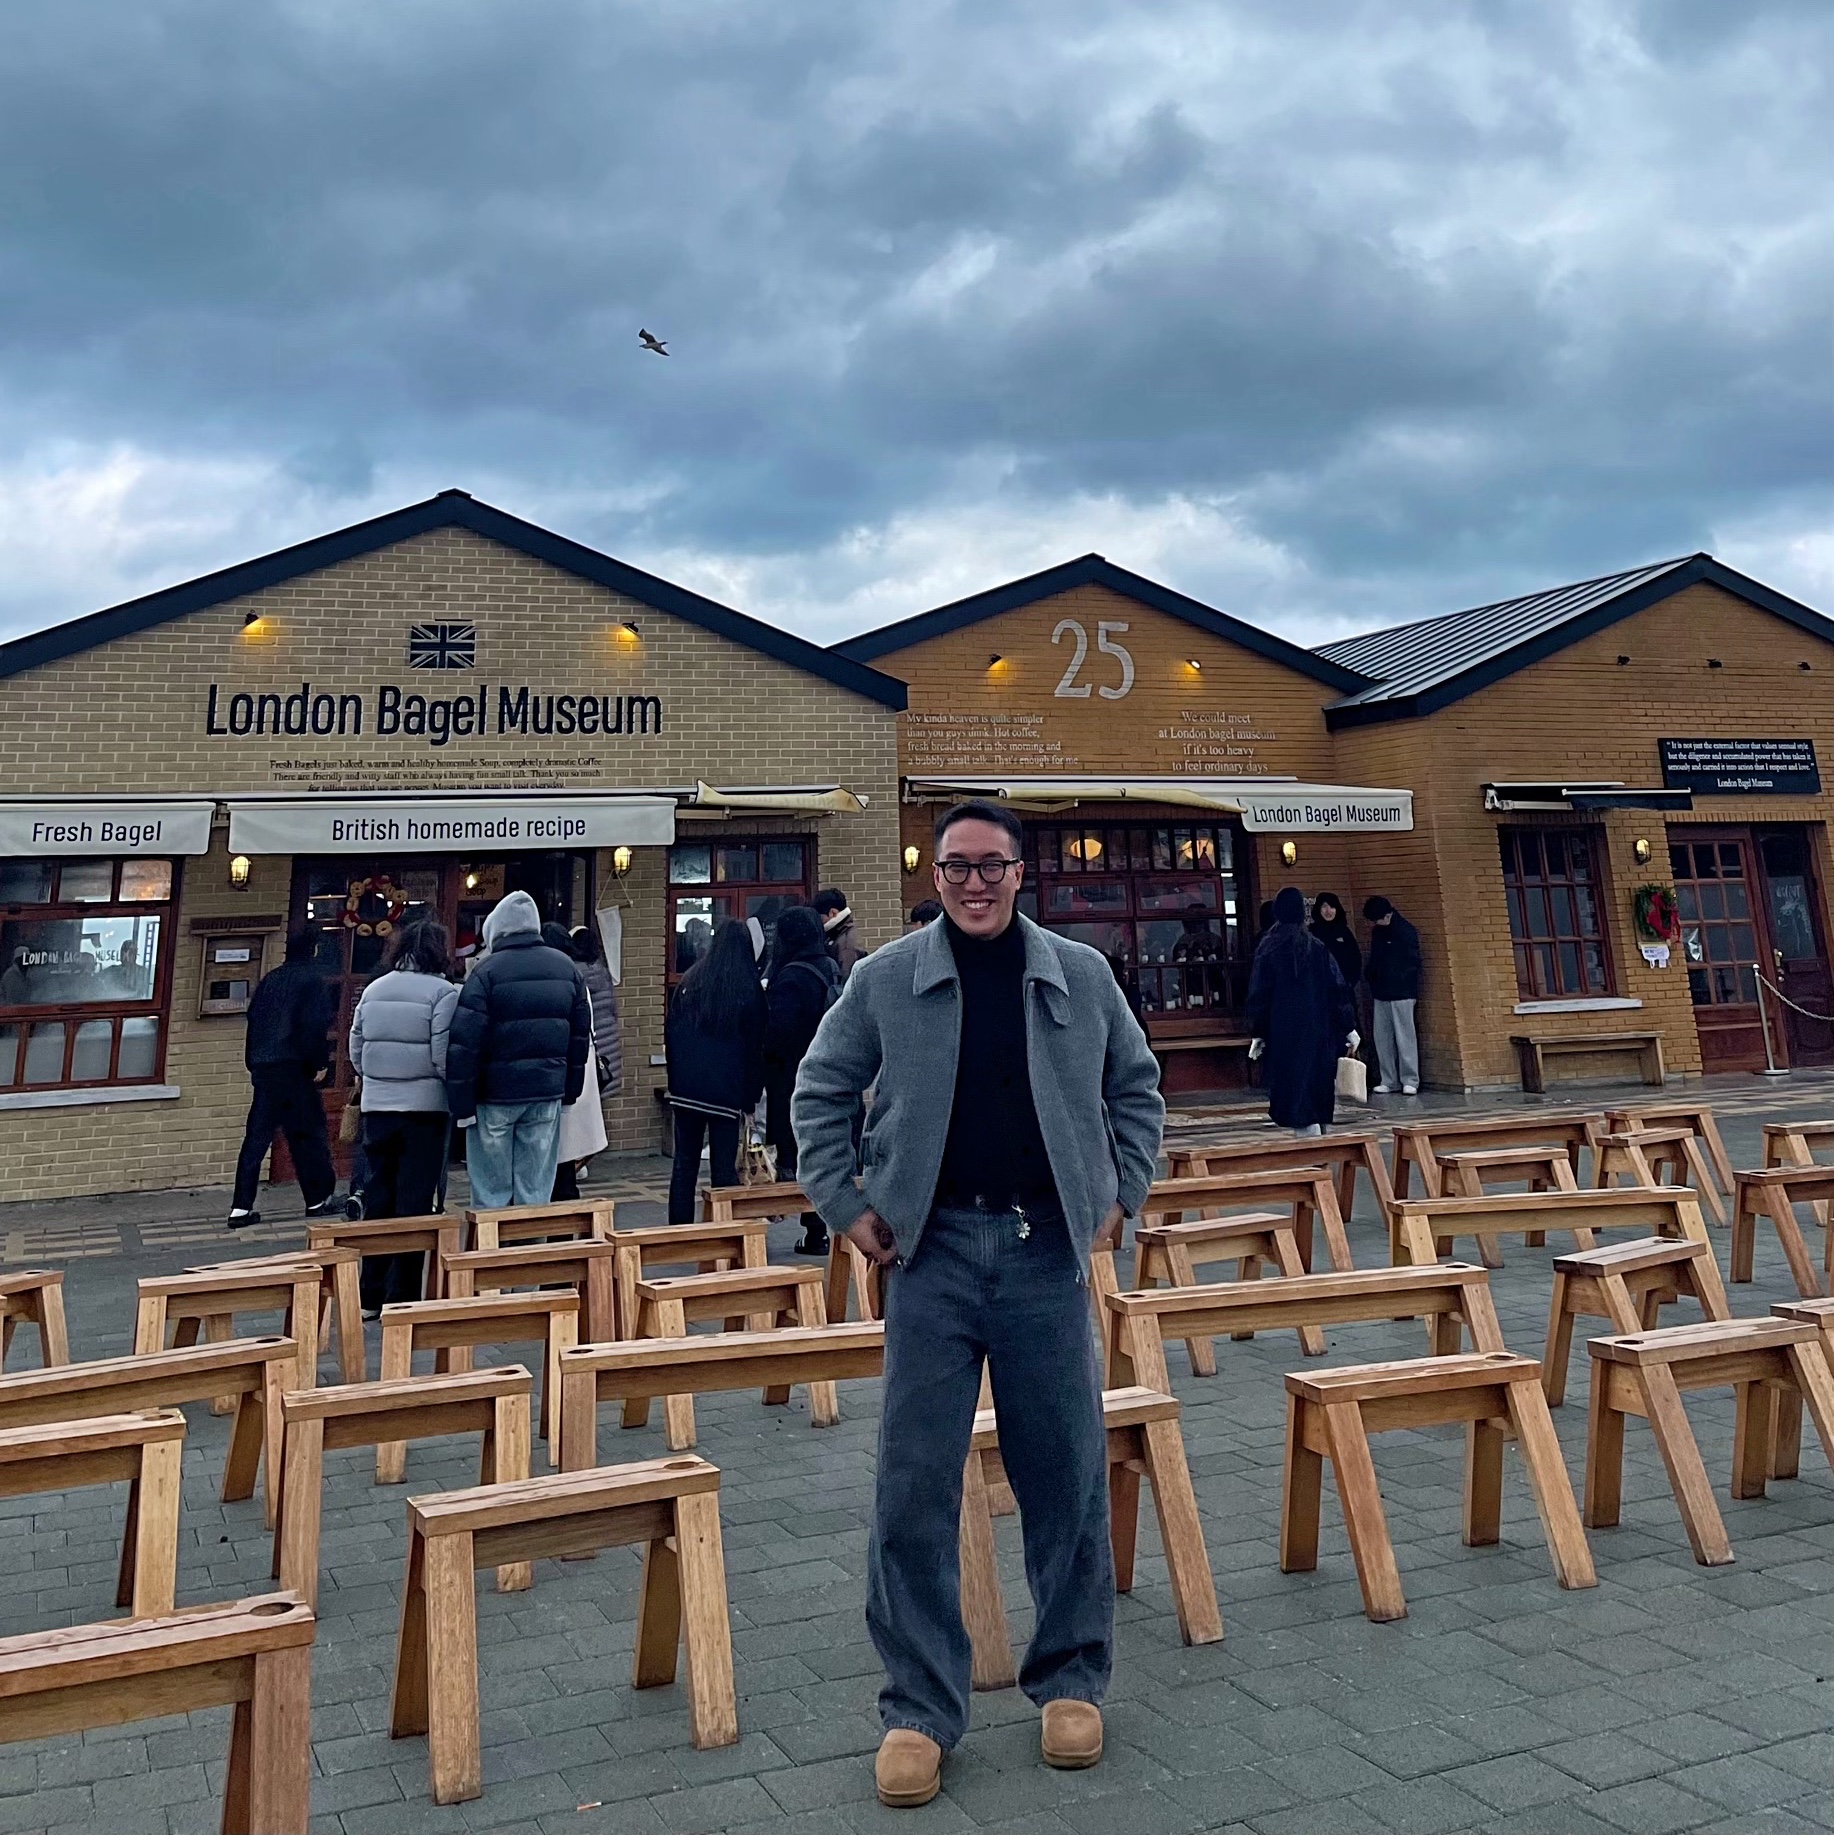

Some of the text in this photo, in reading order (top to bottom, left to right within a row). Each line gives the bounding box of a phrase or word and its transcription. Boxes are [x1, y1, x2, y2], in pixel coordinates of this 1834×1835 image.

[1051, 619, 1135, 700] 25
[206, 683, 662, 746] London Bagel Museum
[907, 713, 1043, 726] My kinda heaven is quite simpler
[1182, 711, 1251, 723] We could meet
[907, 728, 925, 737] than
[928, 731, 943, 740] you
[946, 731, 966, 740] guys
[994, 728, 1010, 737] Hot
[1012, 728, 1040, 738] coffee,
[1159, 728, 1167, 738] at
[1170, 727, 1207, 739] London
[1209, 728, 1234, 741] bagel
[908, 741, 1061, 753] fresh bread baked in the morning and
[1183, 743, 1193, 755] if
[1210, 745, 1224, 755] too
[1227, 744, 1254, 758] heavy
[1693, 742, 1703, 751] just
[270, 759, 291, 768] Fresh
[295, 759, 321, 770] Bagels
[323, 760, 337, 770] just
[340, 759, 364, 769] baked,
[391, 759, 404, 768] and
[407, 759, 434, 769] healthy
[437, 759, 477, 768] homemade
[480, 759, 500, 768] Soup,
[503, 758, 542, 768] completely
[545, 758, 576, 766] dramatic
[578, 757, 601, 766] Coffee
[916, 755, 945, 767] bubbly
[947, 755, 969, 765] small
[1019, 757, 1049, 768] enough
[1051, 755, 1063, 764] for
[1688, 753, 1711, 761] diligence
[1172, 760, 1268, 774] to feel ordinary days
[1668, 763, 1690, 772] seriously
[1769, 764, 1787, 772] respect
[273, 772, 295, 781] There
[313, 772, 342, 782] friendly
[345, 771, 359, 780] and
[362, 771, 380, 781] witty
[383, 771, 400, 779] staff
[403, 771, 417, 779] who
[421, 771, 447, 780] always
[449, 771, 474, 779] having
[491, 770, 510, 778] small
[555, 771, 569, 779] you
[581, 769, 601, 777] much
[1717, 778, 1773, 789] London Bagel Museum
[1252, 805, 1400, 827] London Bagel Museum
[332, 813, 586, 841] British homemade recipe
[33, 821, 162, 847] Fresh Bagel
